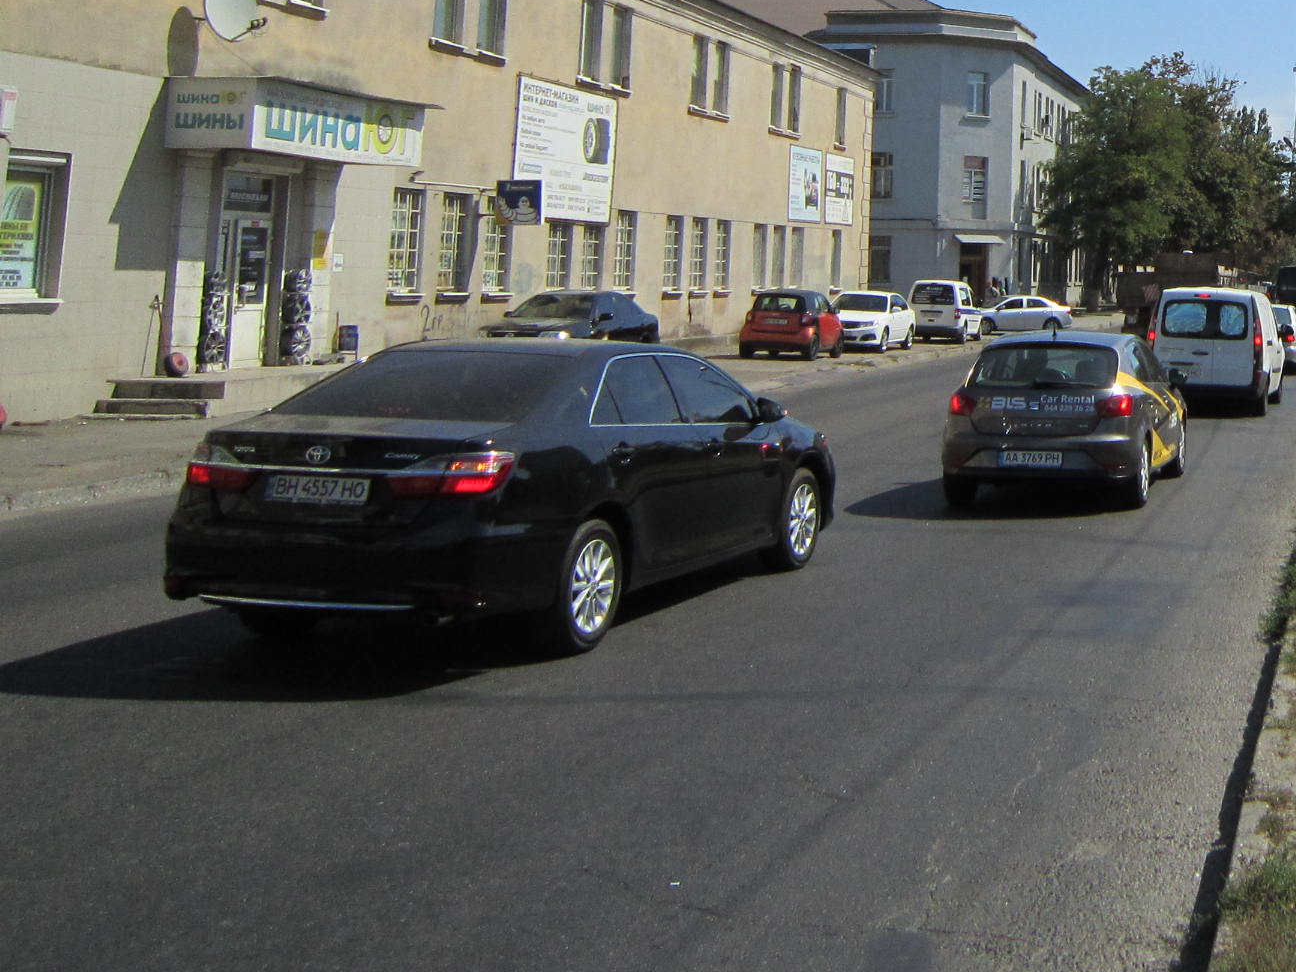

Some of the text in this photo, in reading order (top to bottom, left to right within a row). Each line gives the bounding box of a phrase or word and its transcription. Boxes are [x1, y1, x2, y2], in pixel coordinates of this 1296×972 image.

[1040, 394, 1095, 404] Car Rental
[1005, 452, 1018, 462] AA
[1021, 452, 1043, 463] 3769
[275, 477, 367, 499] BH 4557 HO
